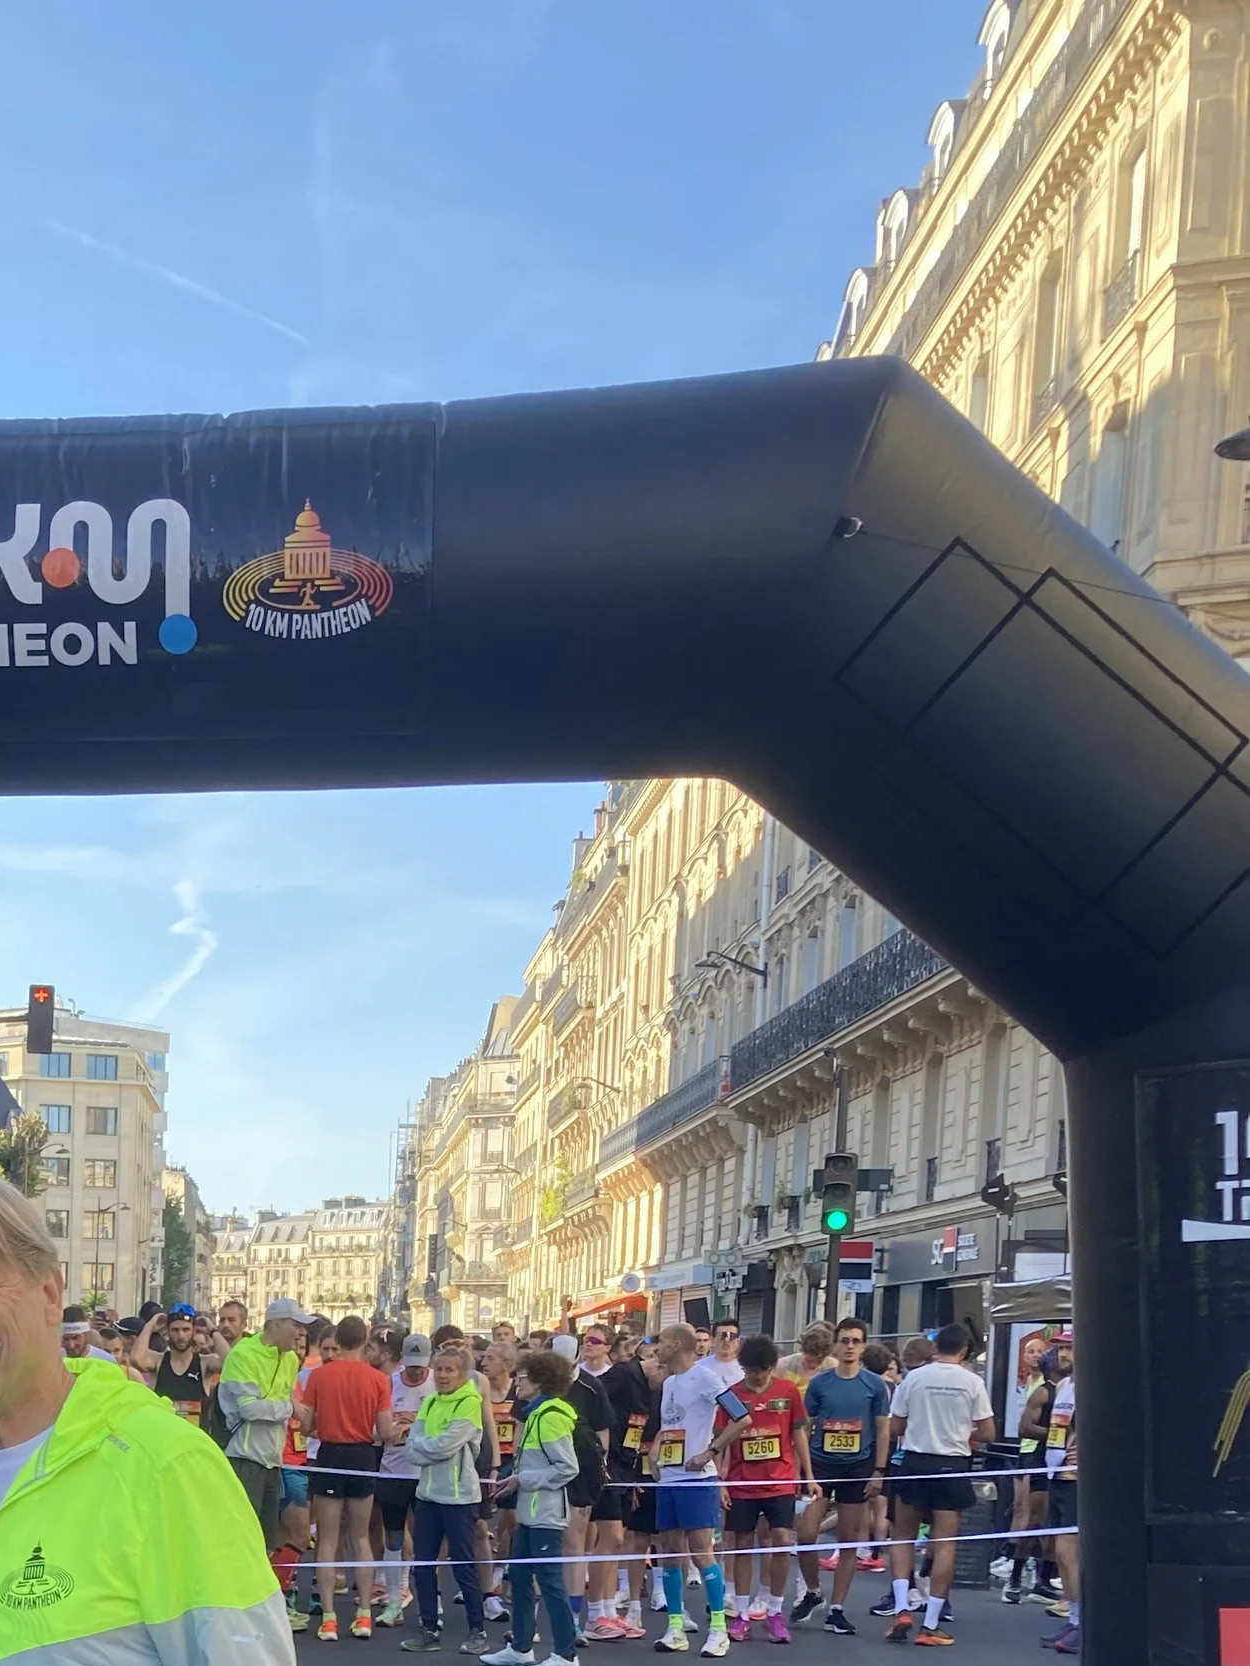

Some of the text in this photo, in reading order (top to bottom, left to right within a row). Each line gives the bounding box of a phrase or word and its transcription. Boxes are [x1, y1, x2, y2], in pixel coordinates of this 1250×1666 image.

[245, 597, 372, 639] 10 KM PANTHEON
[747, 1440, 775, 1455] 5260
[829, 1434, 855, 1448] 2533
[24, 1589, 62, 1610] PANTHEON
